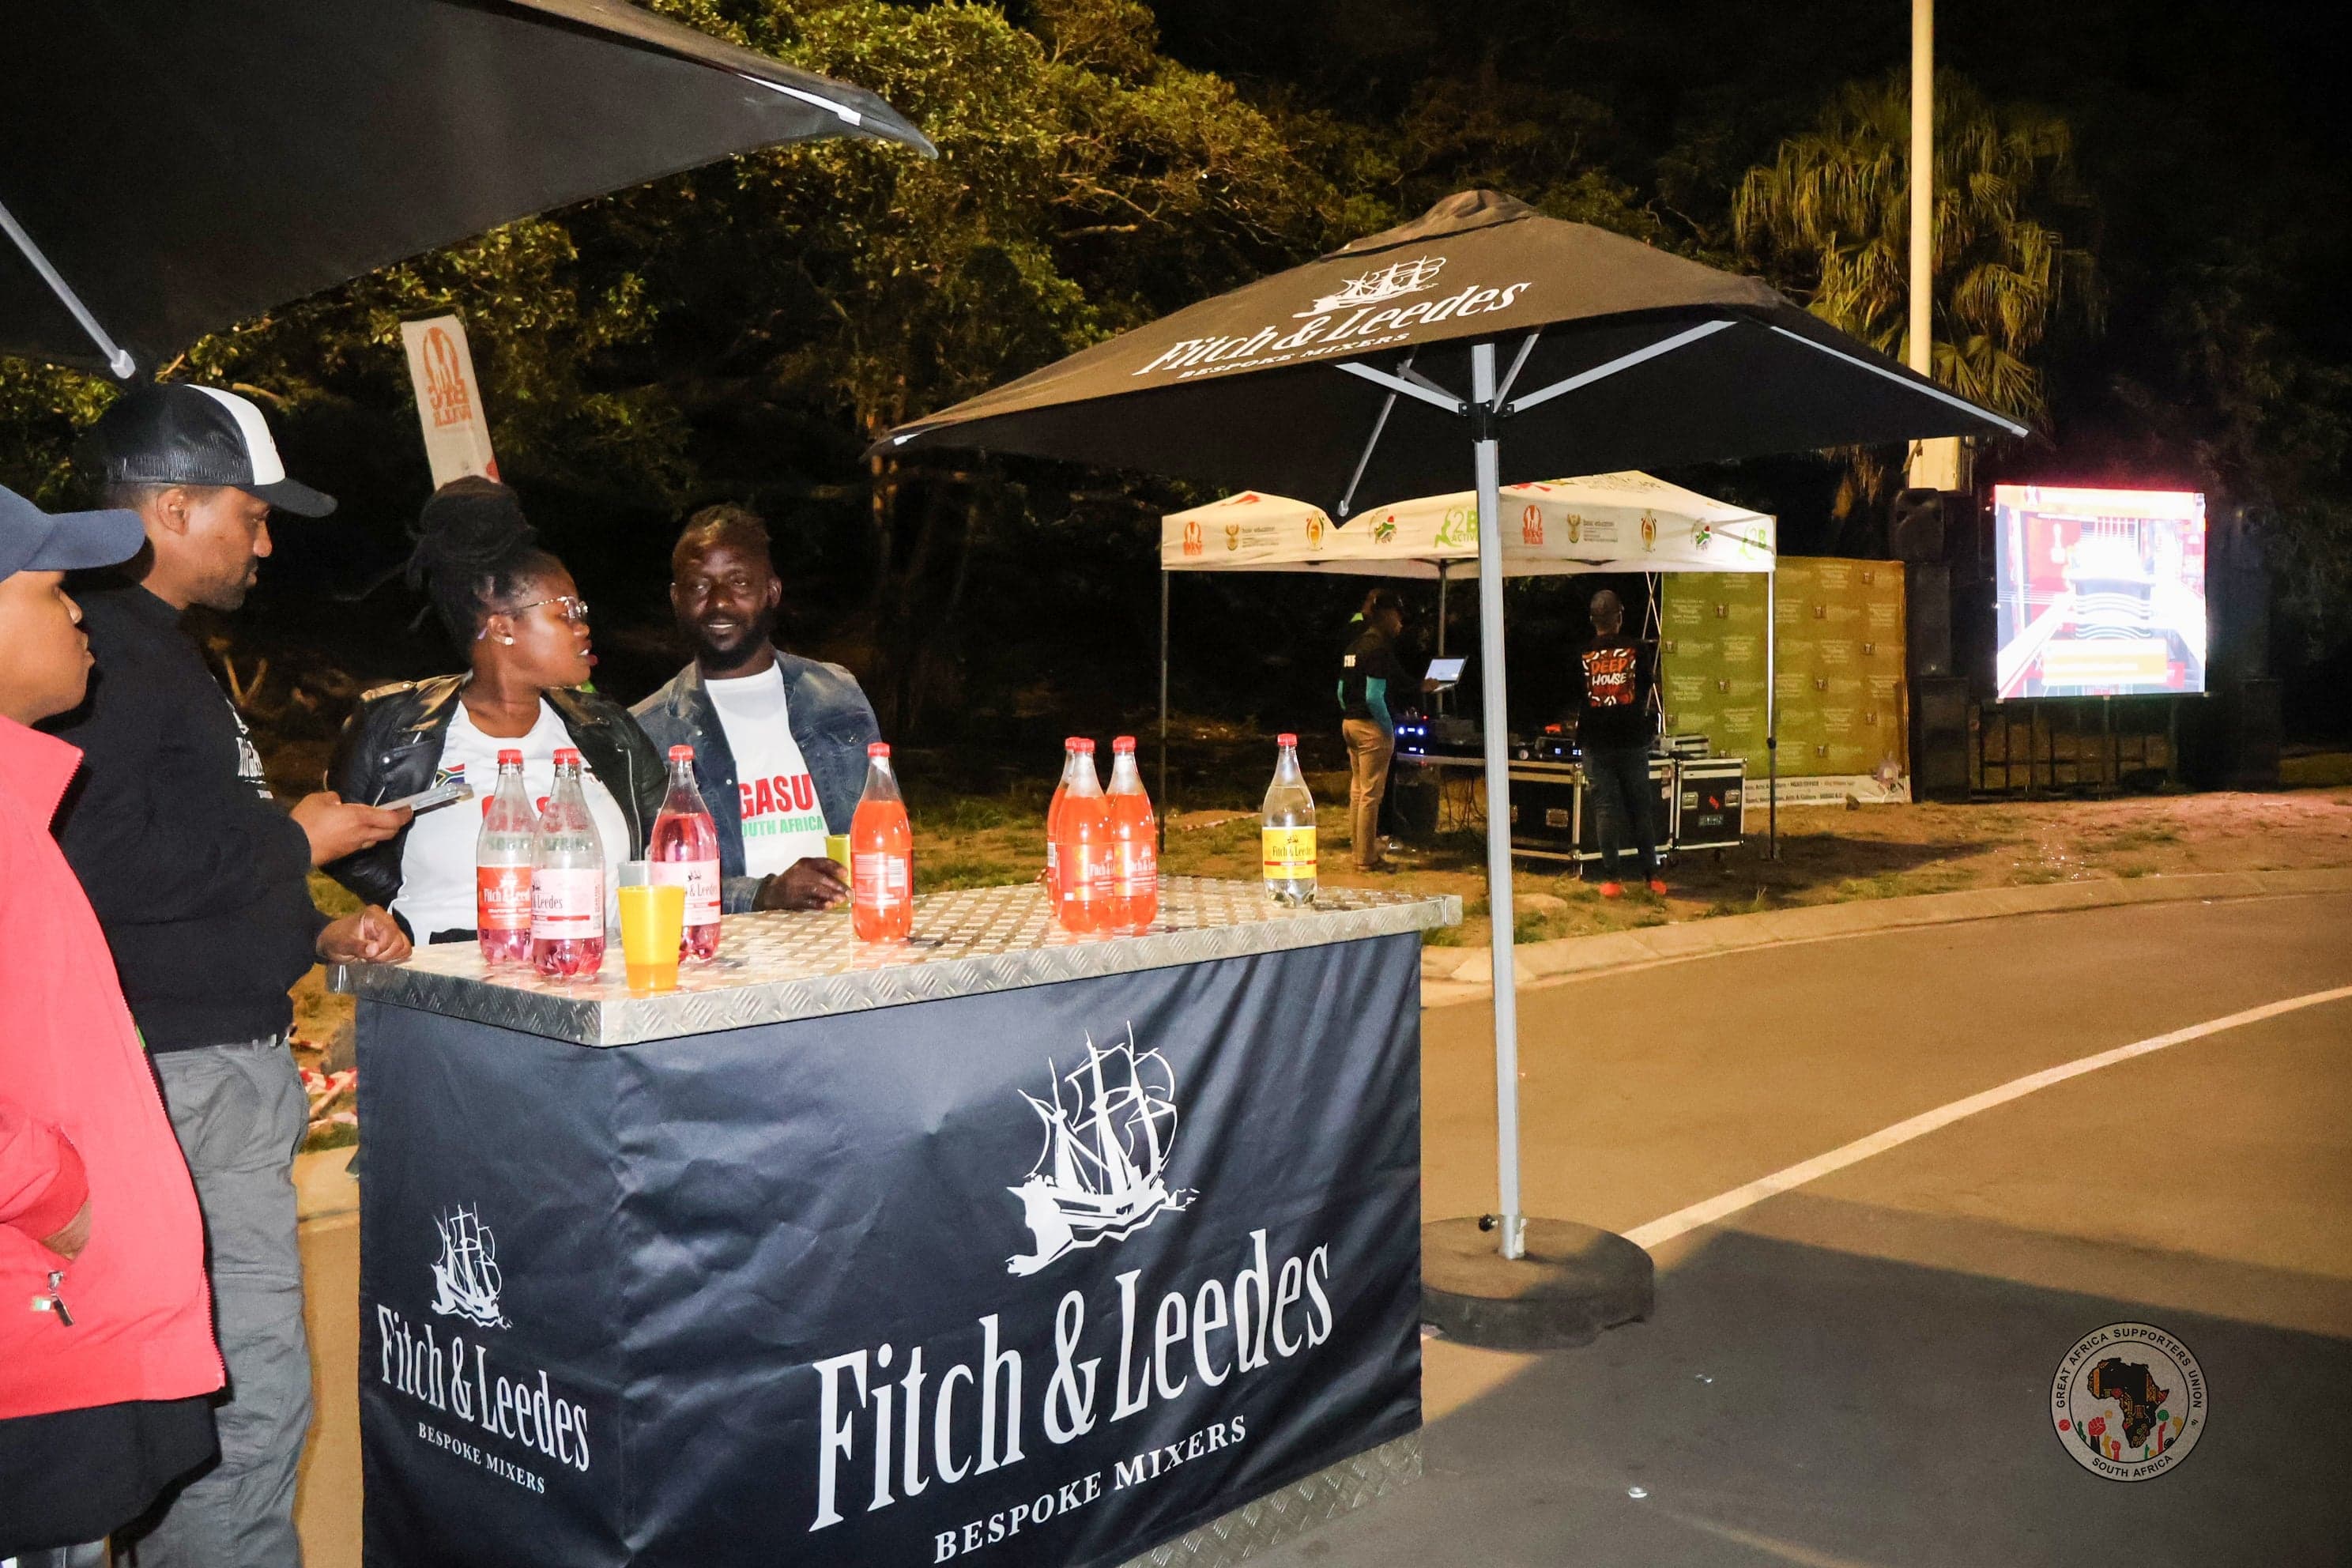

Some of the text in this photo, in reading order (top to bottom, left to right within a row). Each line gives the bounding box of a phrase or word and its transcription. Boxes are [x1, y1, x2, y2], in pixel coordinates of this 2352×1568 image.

[1132, 282, 1532, 375] Fitch & Leedes
[1177, 333, 1410, 379] BESPOKE MIXERS
[1451, 533, 1478, 542] ACTIV
[1591, 658, 1628, 675] DEEP
[1592, 673, 1627, 686] HOUSE
[738, 774, 814, 819] GASU
[742, 816, 824, 838] OUTH AFRICA
[537, 894, 563, 909] Leedes
[378, 1303, 590, 1472] Fitch & Leedes
[808, 1228, 1333, 1532] Fitch & Leedes
[418, 1422, 545, 1494] BESPOKE MIXERS
[934, 1414, 1248, 1565] BESPOKE MIXERS
